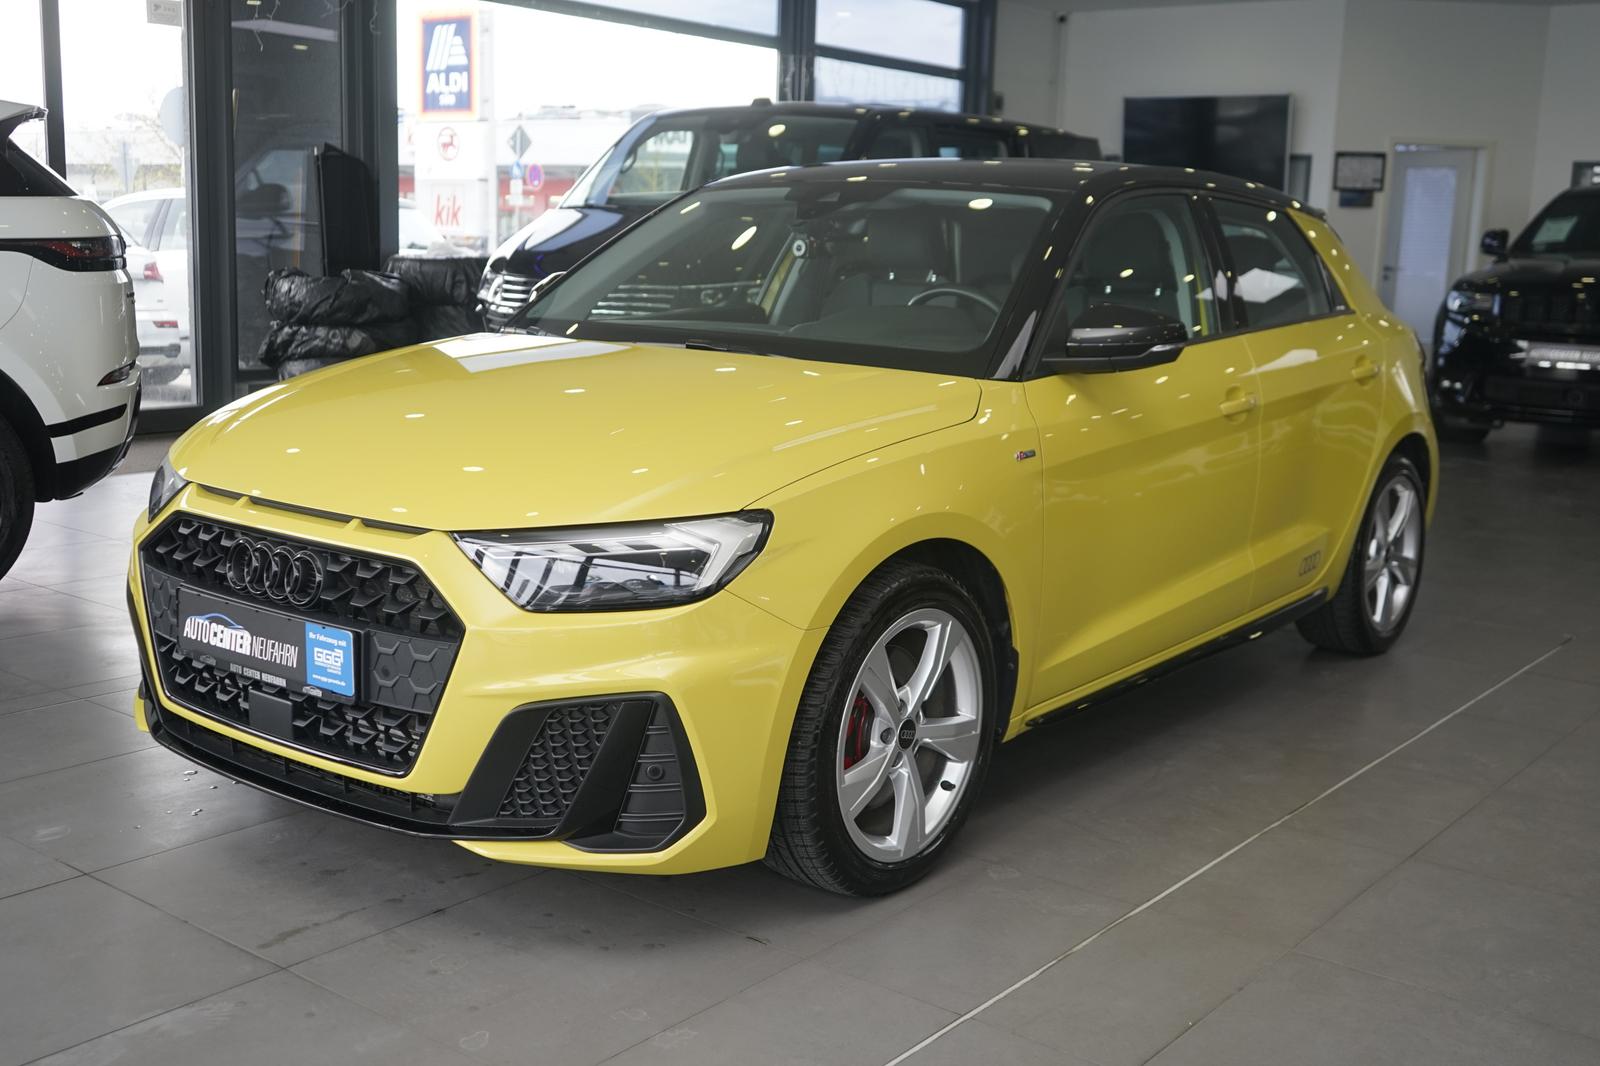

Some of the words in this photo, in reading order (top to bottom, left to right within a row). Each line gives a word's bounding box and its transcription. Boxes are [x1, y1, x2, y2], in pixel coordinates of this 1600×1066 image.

[426, 71, 468, 94] ALDI
[435, 193, 461, 226] kik
[251, 635, 299, 669] NEUFAHRN
[242, 666, 261, 680] CENTER
